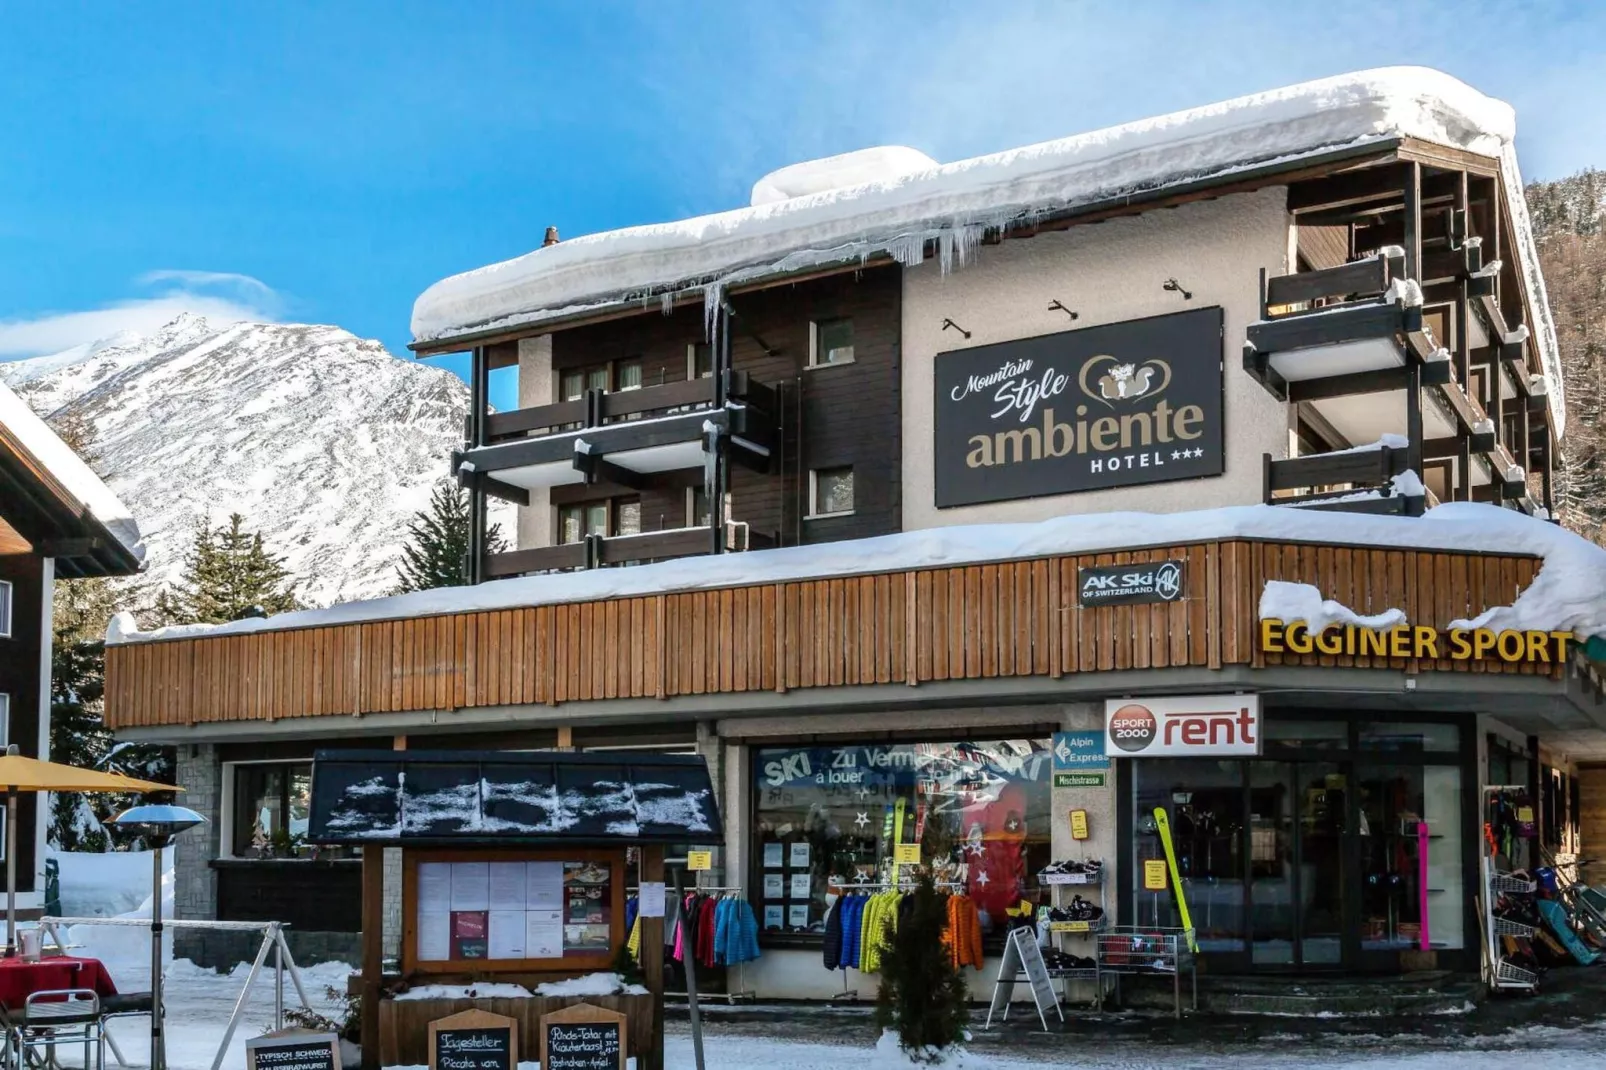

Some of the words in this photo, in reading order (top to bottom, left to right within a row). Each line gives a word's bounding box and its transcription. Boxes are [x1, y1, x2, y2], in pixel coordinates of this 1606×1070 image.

[951, 358, 1033, 401] Mountain
[990, 367, 1070, 422] Style
[966, 399, 1204, 469] ambiente
[1091, 452, 1164, 473] HOTEL
[1083, 575, 1118, 590] AK
[1121, 572, 1153, 588] Ski
[1082, 590, 1095, 598] OF
[1095, 586, 1153, 598] SWITZERLAND
[1261, 617, 1439, 659] EGGINER
[1450, 627, 1574, 664] SPORT
[1113, 718, 1152, 729] SPORT
[1164, 707, 1255, 746] rent
[1070, 736, 1094, 748] Alpin
[1116, 728, 1149, 738] 2000
[831, 749, 857, 768] Zu
[1069, 753, 1109, 764] Express
[764, 751, 812, 786] SKI
[828, 769, 865, 784] louer
[440, 1033, 502, 1051] Tagesteller
[259, 1050, 292, 1060] TYPISCH
[295, 1048, 329, 1058] SCHWEIZ
